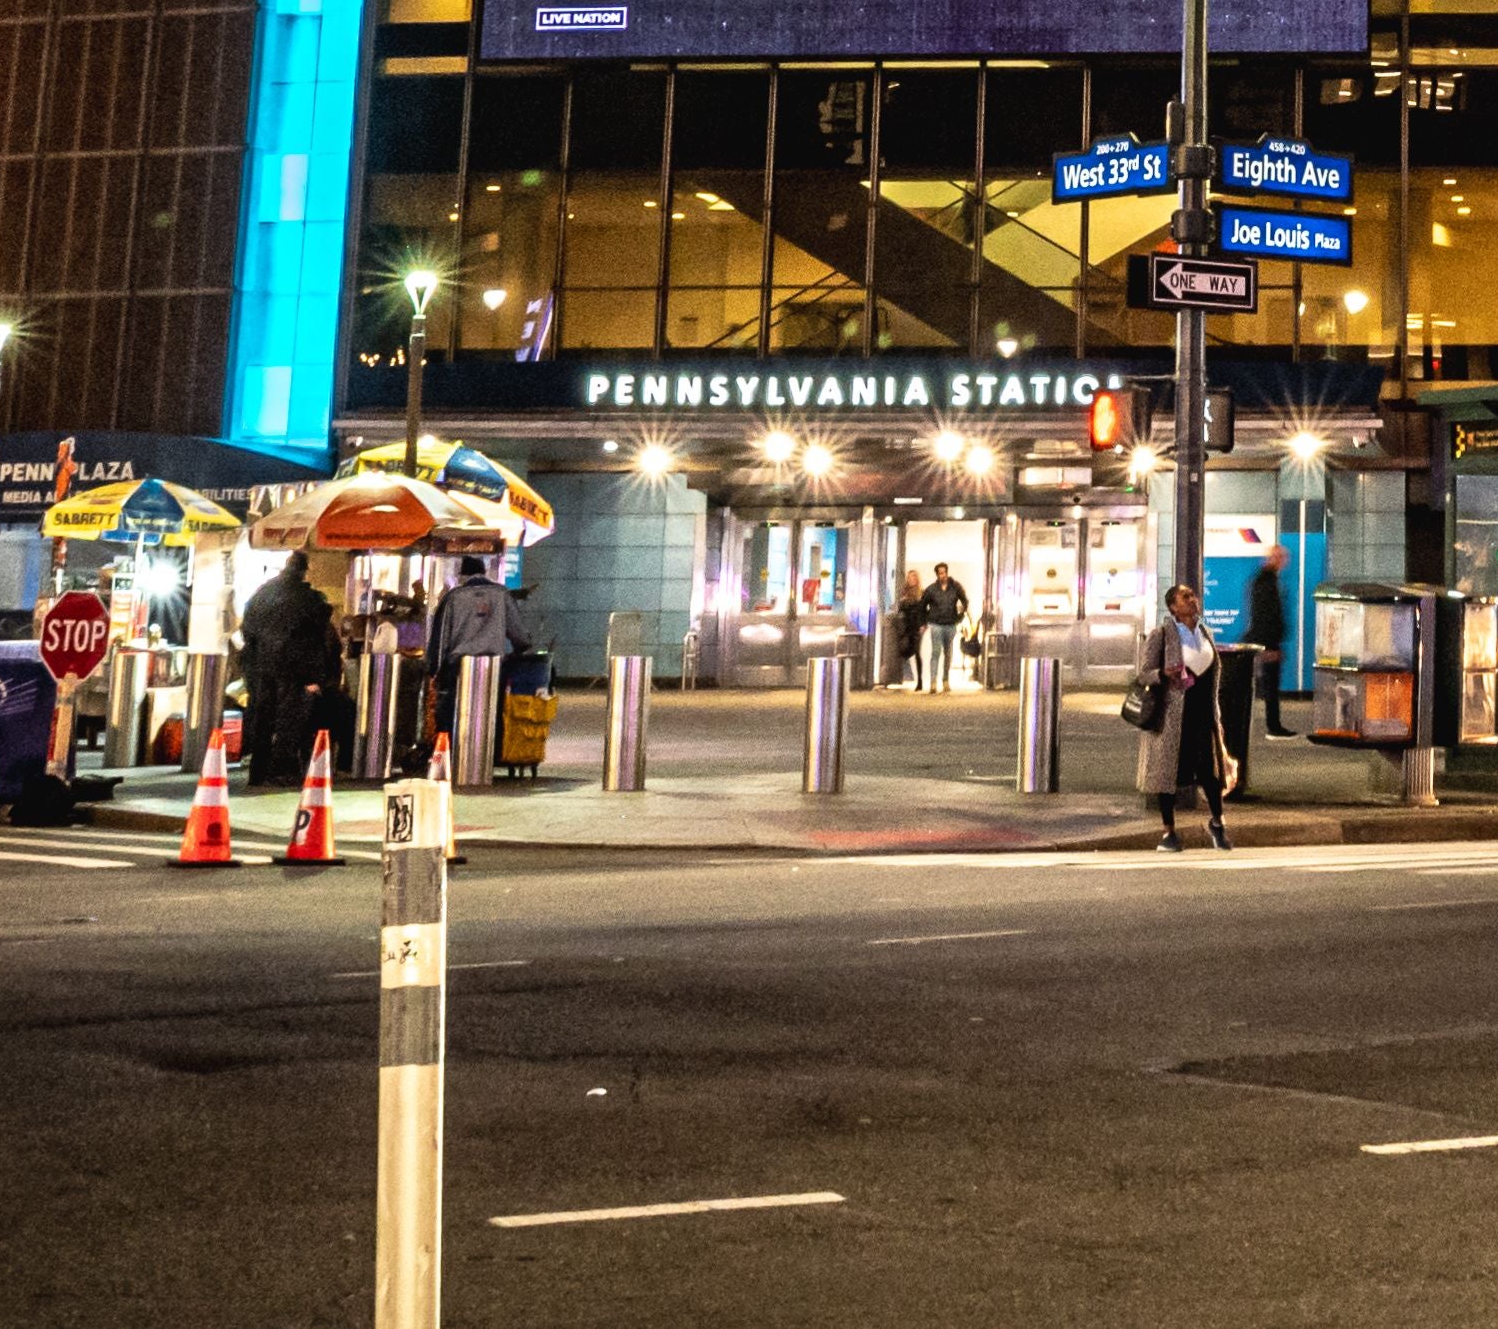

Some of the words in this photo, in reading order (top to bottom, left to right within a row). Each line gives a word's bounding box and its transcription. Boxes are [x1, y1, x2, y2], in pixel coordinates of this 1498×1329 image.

[542, 13, 571, 24] LIVE
[573, 12, 621, 23] NATION
[1063, 163, 1106, 191] West
[1108, 155, 1140, 183] 33rd
[1143, 154, 1162, 180] St
[1232, 152, 1297, 188] Eighth
[1301, 162, 1341, 189] Ave
[1230, 219, 1261, 245] Joe
[1265, 221, 1311, 250] Louis
[1314, 233, 1342, 250] Plaza
[1170, 273, 1197, 291] ONE
[1209, 274, 1238, 293] WAY
[587, 375, 929, 406] PENNSYLVANIA
[950, 375, 1124, 406] STATIO
[0, 464, 54, 482] PENN
[3, 491, 41, 503] MEDIA
[53, 512, 114, 526] SABRETT
[46, 620, 106, 653] STOP
